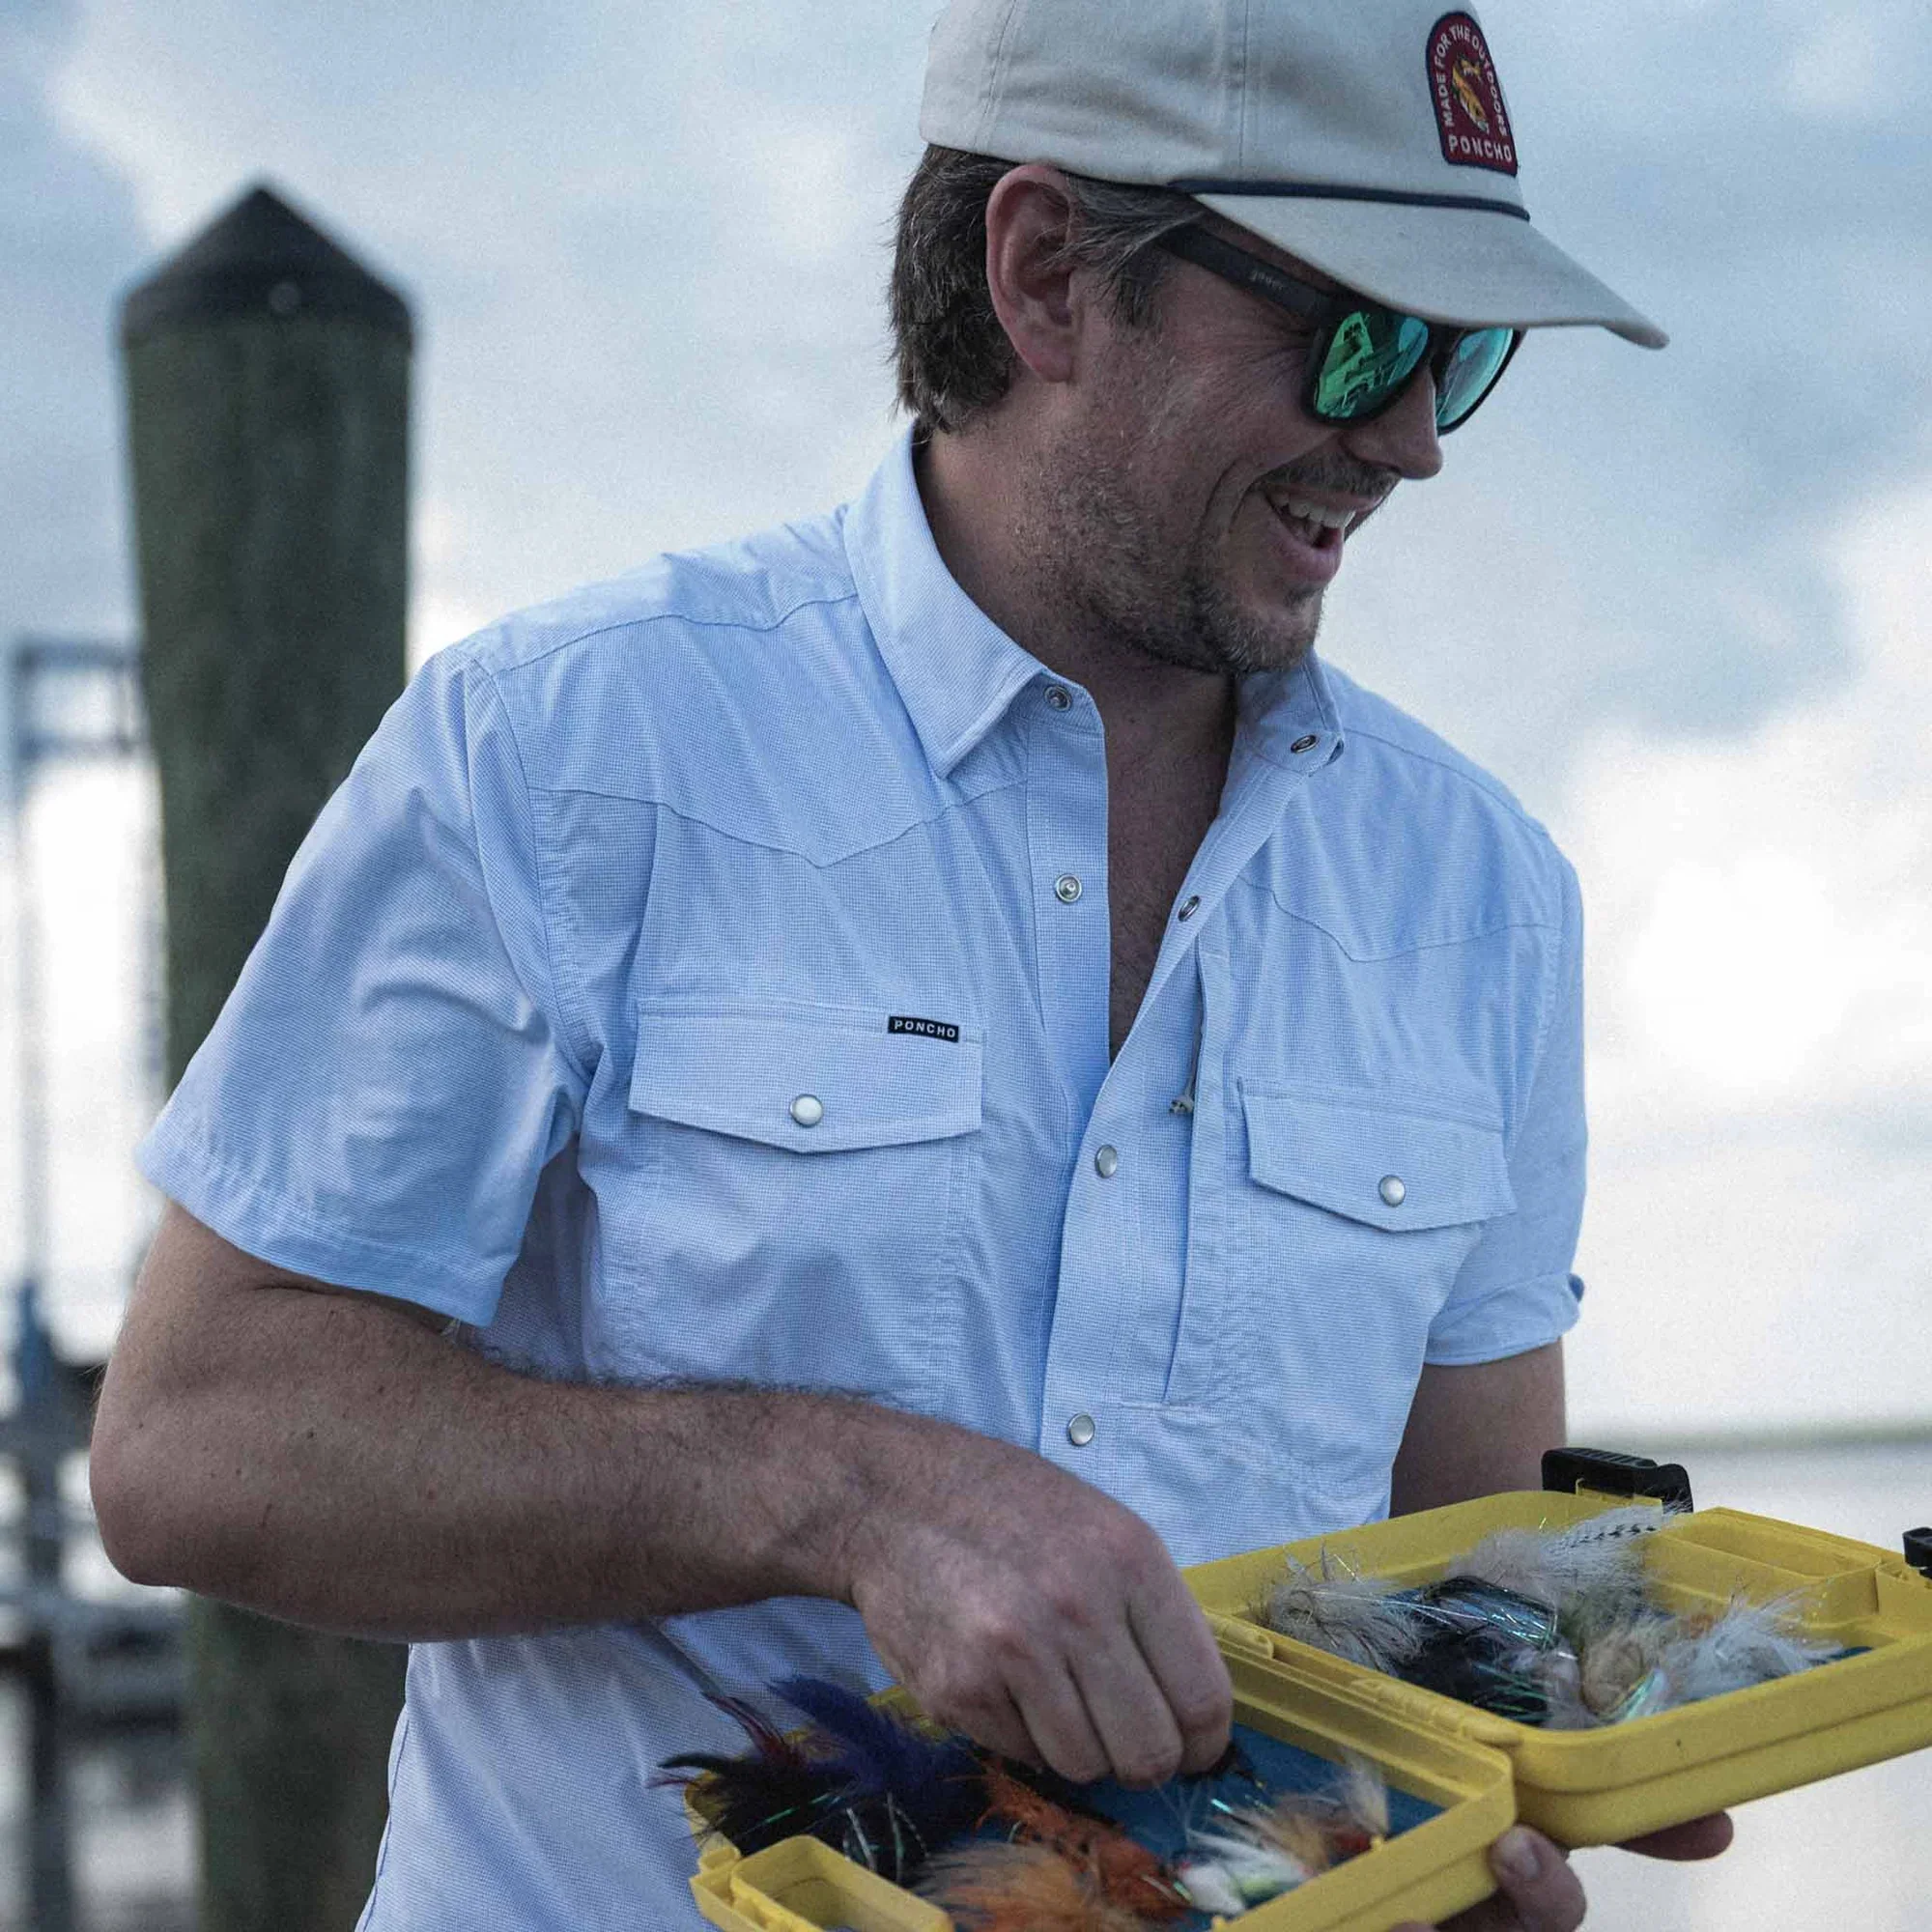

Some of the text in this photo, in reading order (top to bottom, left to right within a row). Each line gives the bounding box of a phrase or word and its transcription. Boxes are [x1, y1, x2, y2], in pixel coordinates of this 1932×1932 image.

[1449, 24, 1471, 43] THE
[1434, 35, 1452, 69] FOR
[1435, 72, 1455, 127] MADE
[1448, 134, 1512, 162] PONCHO
[895, 1019, 956, 1037] PONCHO
